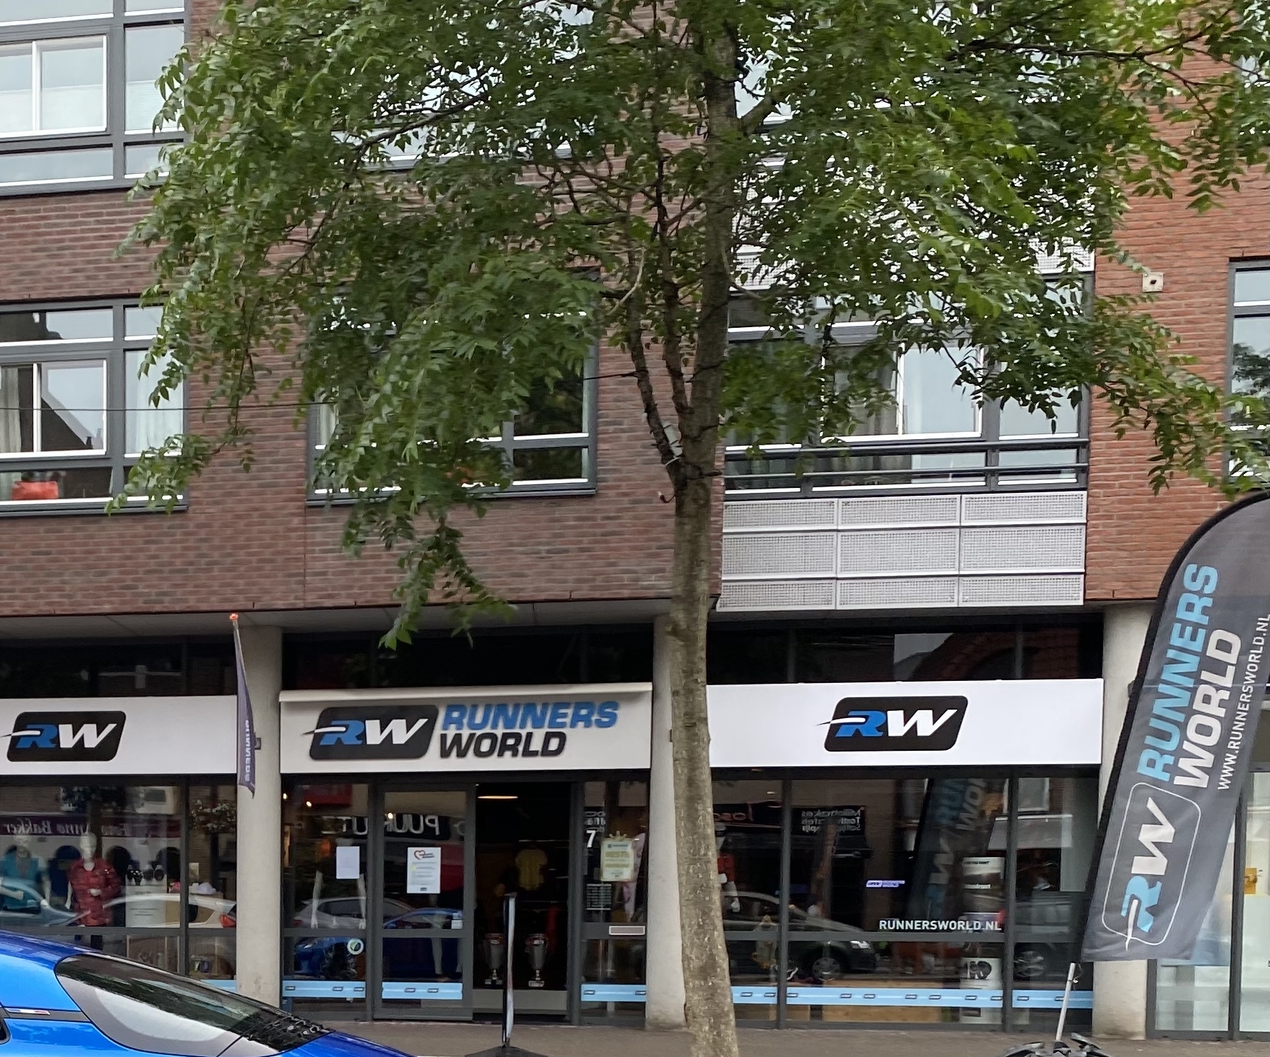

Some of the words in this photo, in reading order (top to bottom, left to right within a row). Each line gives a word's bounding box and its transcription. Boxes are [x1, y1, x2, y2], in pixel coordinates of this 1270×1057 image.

[1137, 563, 1219, 783] RUNNERS
[442, 701, 620, 731] RUNNERS
[1173, 629, 1242, 789] WORLD
[1217, 613, 1270, 791] WWW.RUNNERSWORLD.NL
[14, 723, 118, 749] RW
[318, 718, 429, 746] RW
[833, 709, 958, 738] RW
[439, 731, 568, 758] WORLD
[585, 829, 597, 848] 7
[1121, 797, 1176, 935] RW
[878, 920, 1002, 931] RUNNERSWORLD.NL
